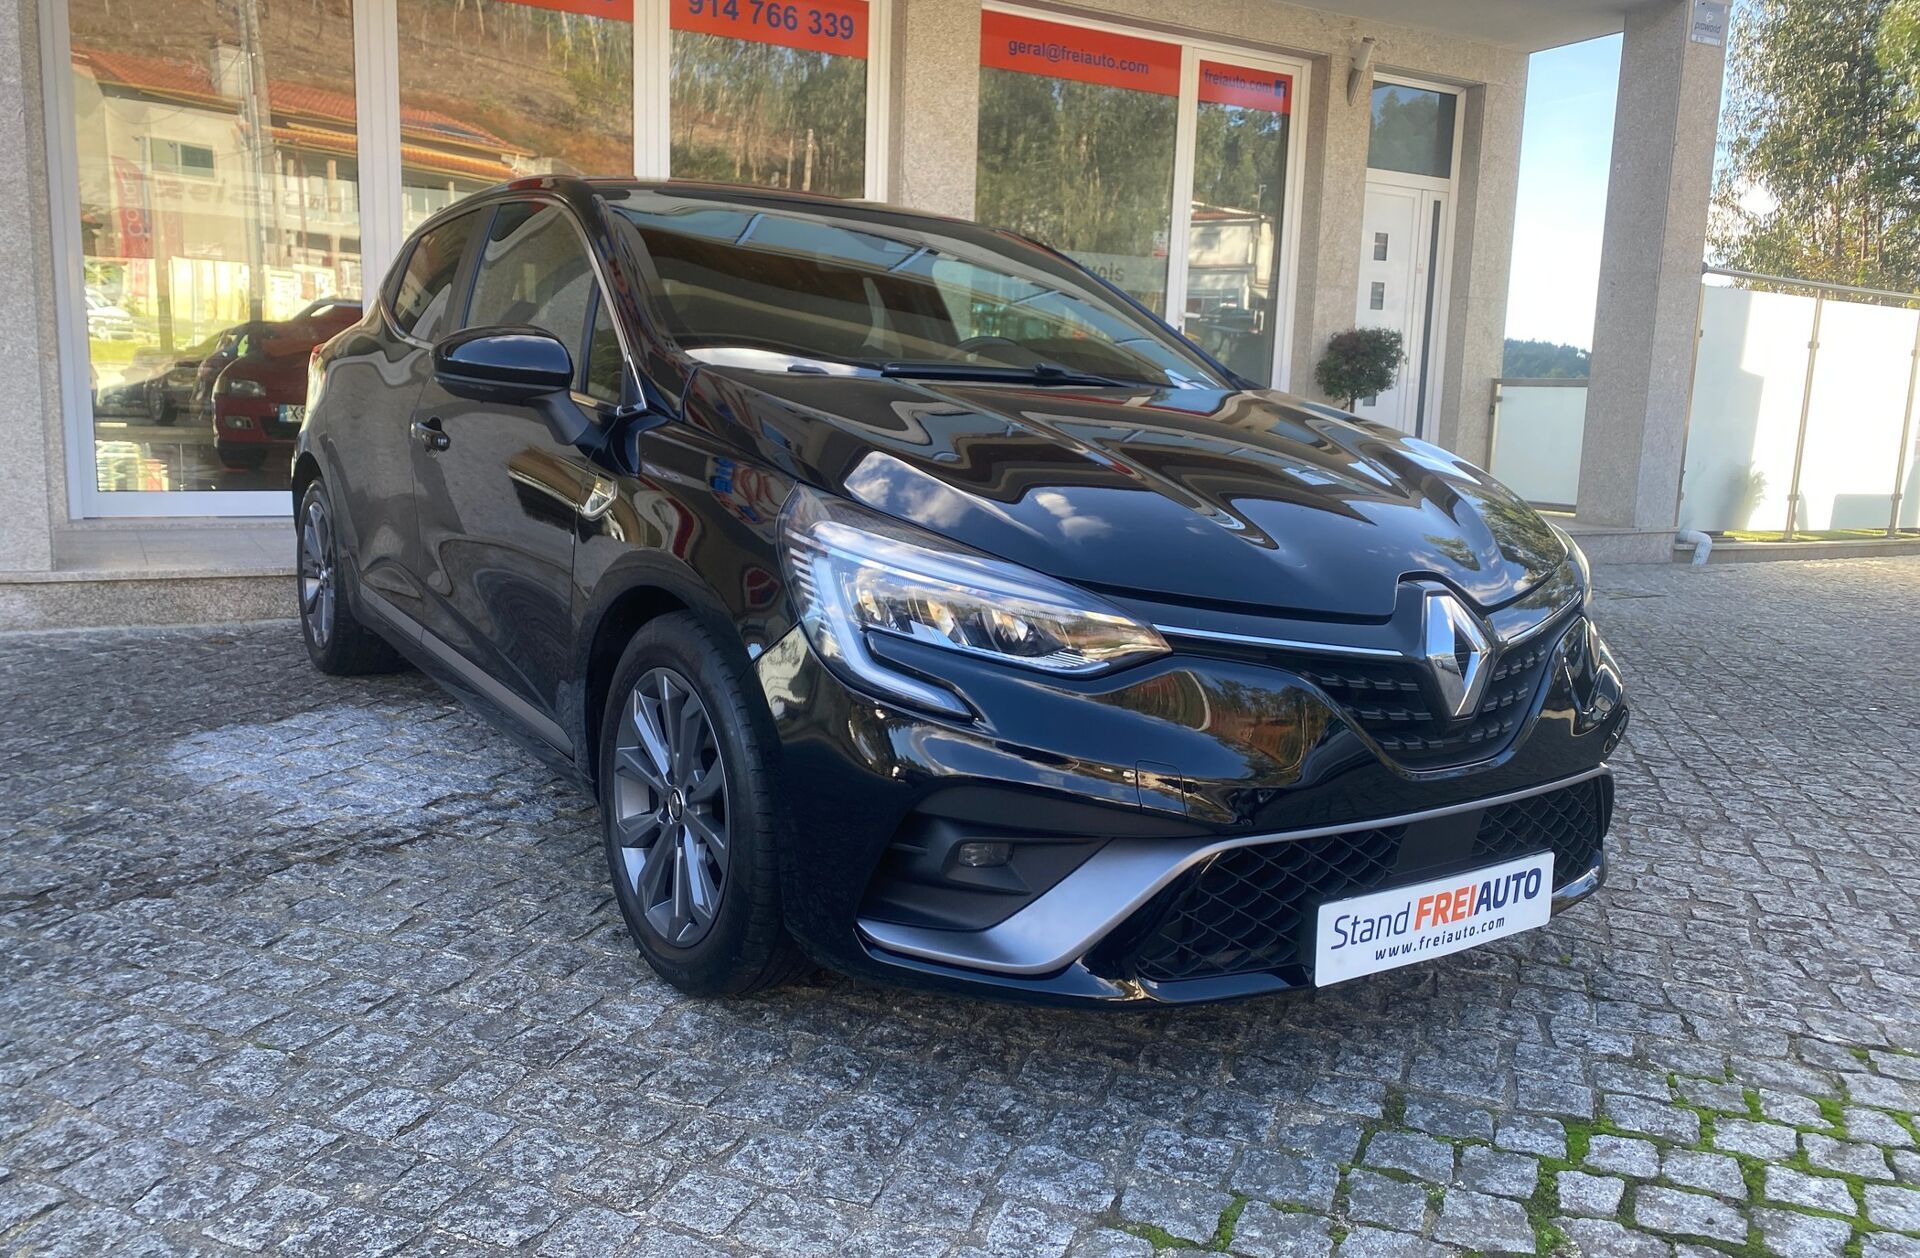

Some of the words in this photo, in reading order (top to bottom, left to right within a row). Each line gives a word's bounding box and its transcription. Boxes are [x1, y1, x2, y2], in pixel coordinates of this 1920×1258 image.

[688, 0, 739, 20] 914
[750, 0, 798, 31] 766
[808, 9, 854, 40] 339
[1008, 39, 1150, 75] geral@freiauto.com
[1204, 69, 1272, 92] freiauto.com
[1331, 902, 1411, 950] Stand
[1414, 868, 1542, 931] FREIAUTO
[1375, 916, 1505, 961] www.freiauto.com
